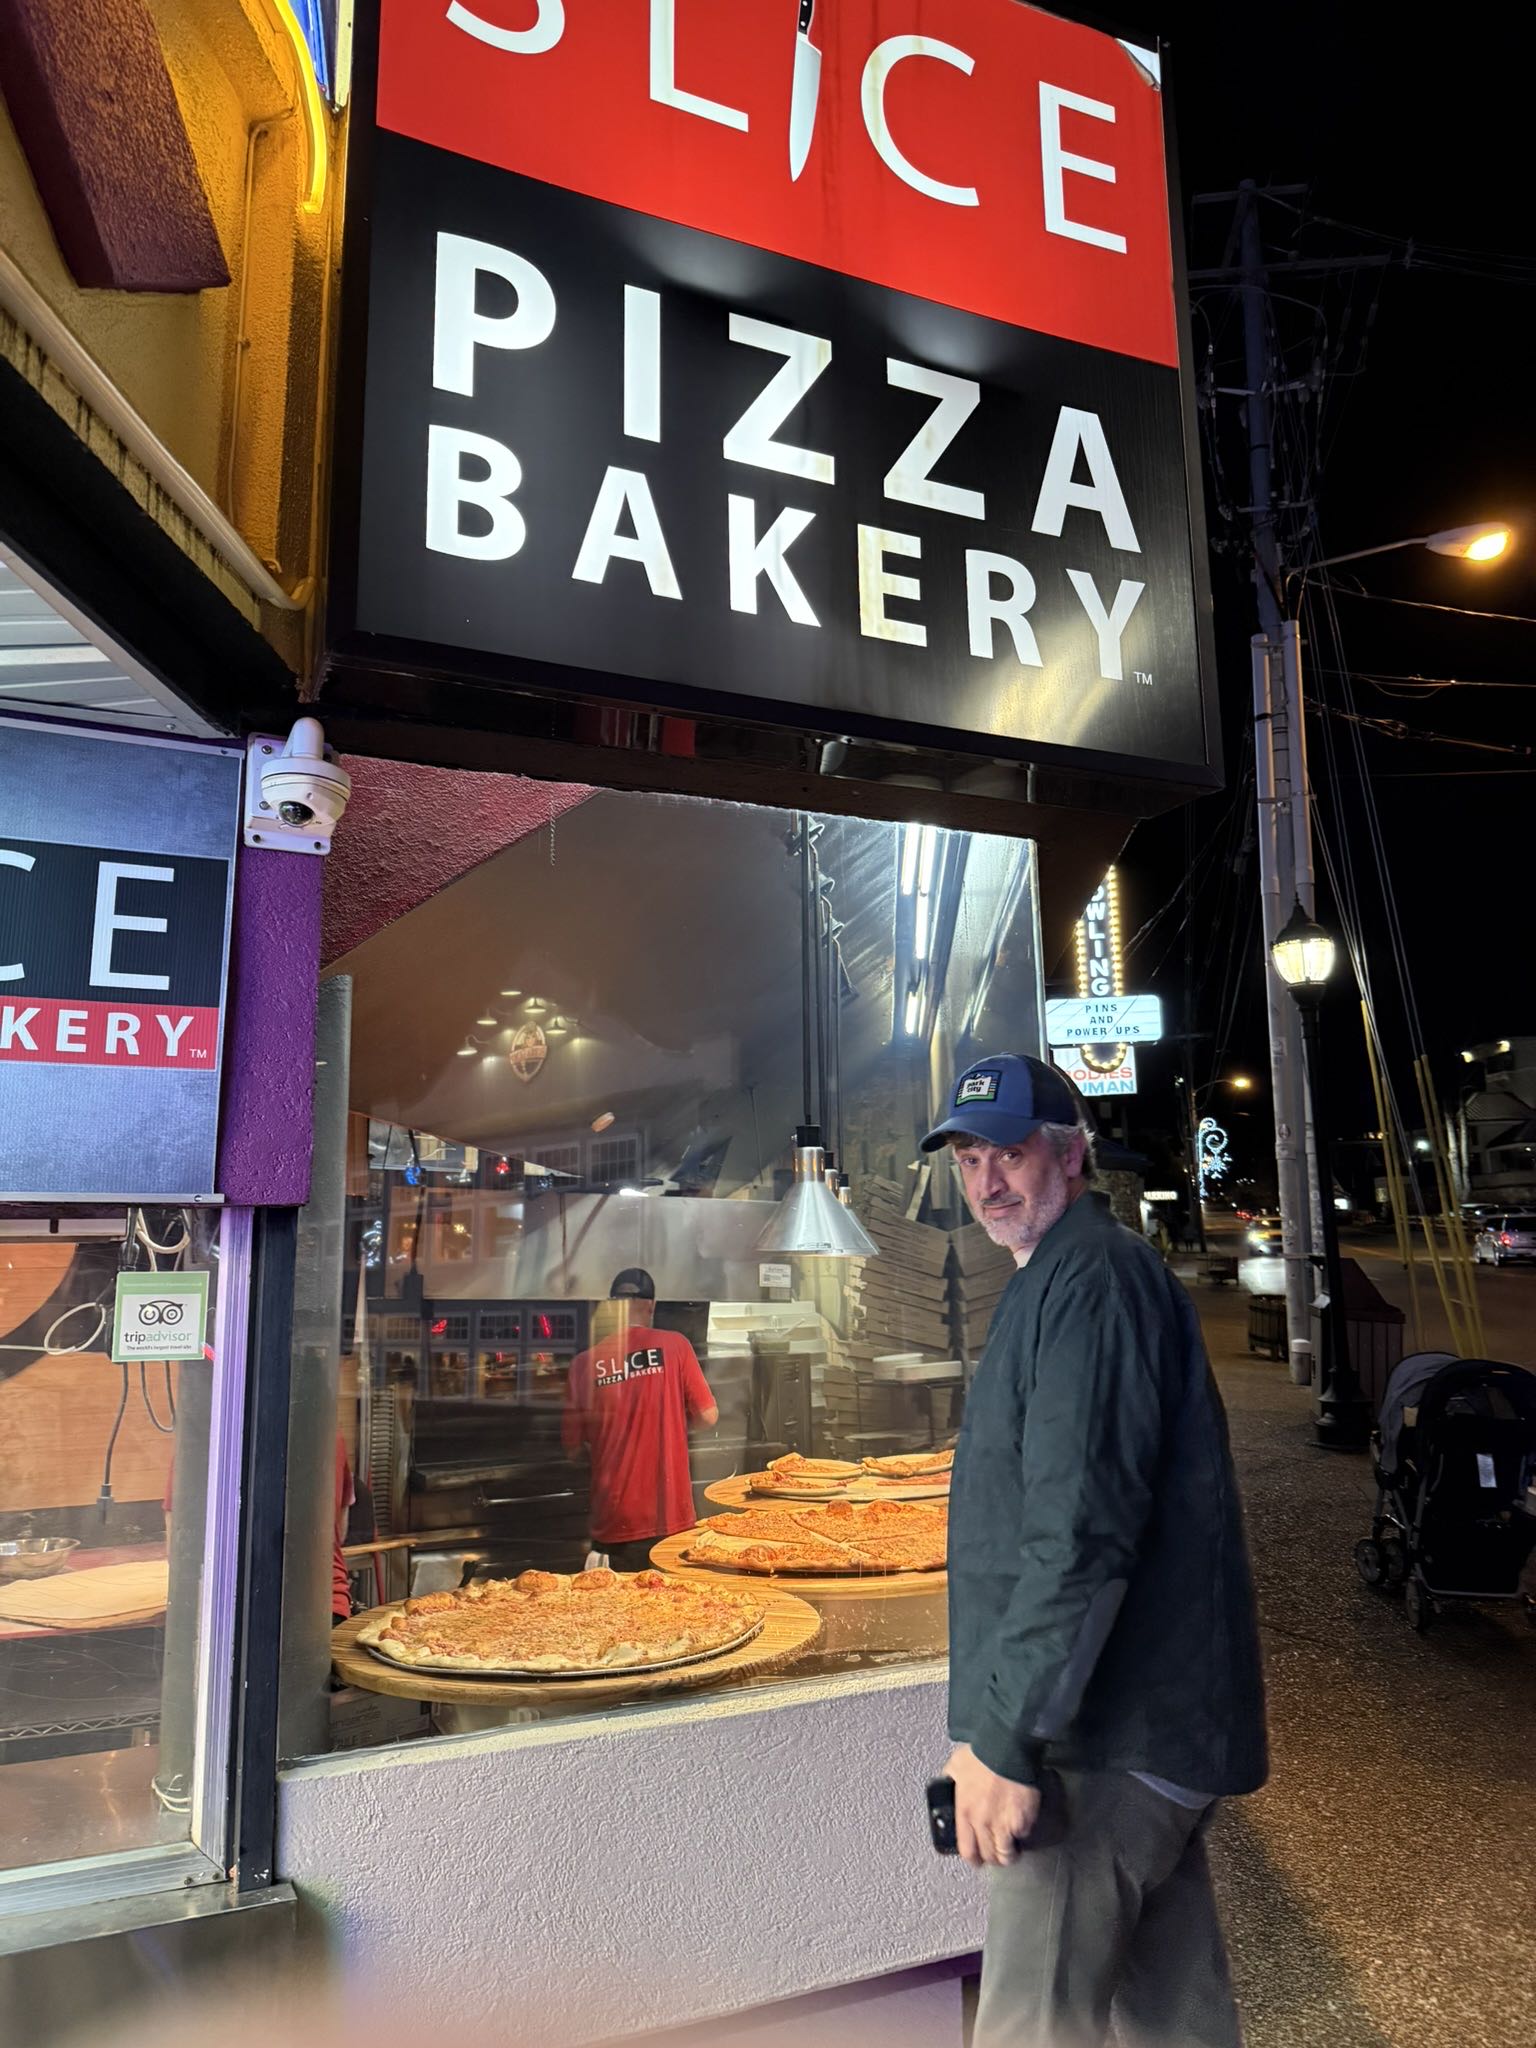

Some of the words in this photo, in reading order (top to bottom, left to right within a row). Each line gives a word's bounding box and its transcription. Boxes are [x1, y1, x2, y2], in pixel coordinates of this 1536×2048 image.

[432, 231, 1142, 553] PIZZA
[425, 424, 1146, 682] BAKERY
[1085, 1003, 1118, 1014] PINS
[1089, 1015, 1114, 1025] AND
[0, 1005, 195, 1057] KERY
[1066, 1027, 1108, 1037] POWER
[1115, 1026, 1141, 1035] UPS
[124, 1331, 192, 1344] tripadvisor
[597, 1374, 623, 1387] PIZZA
